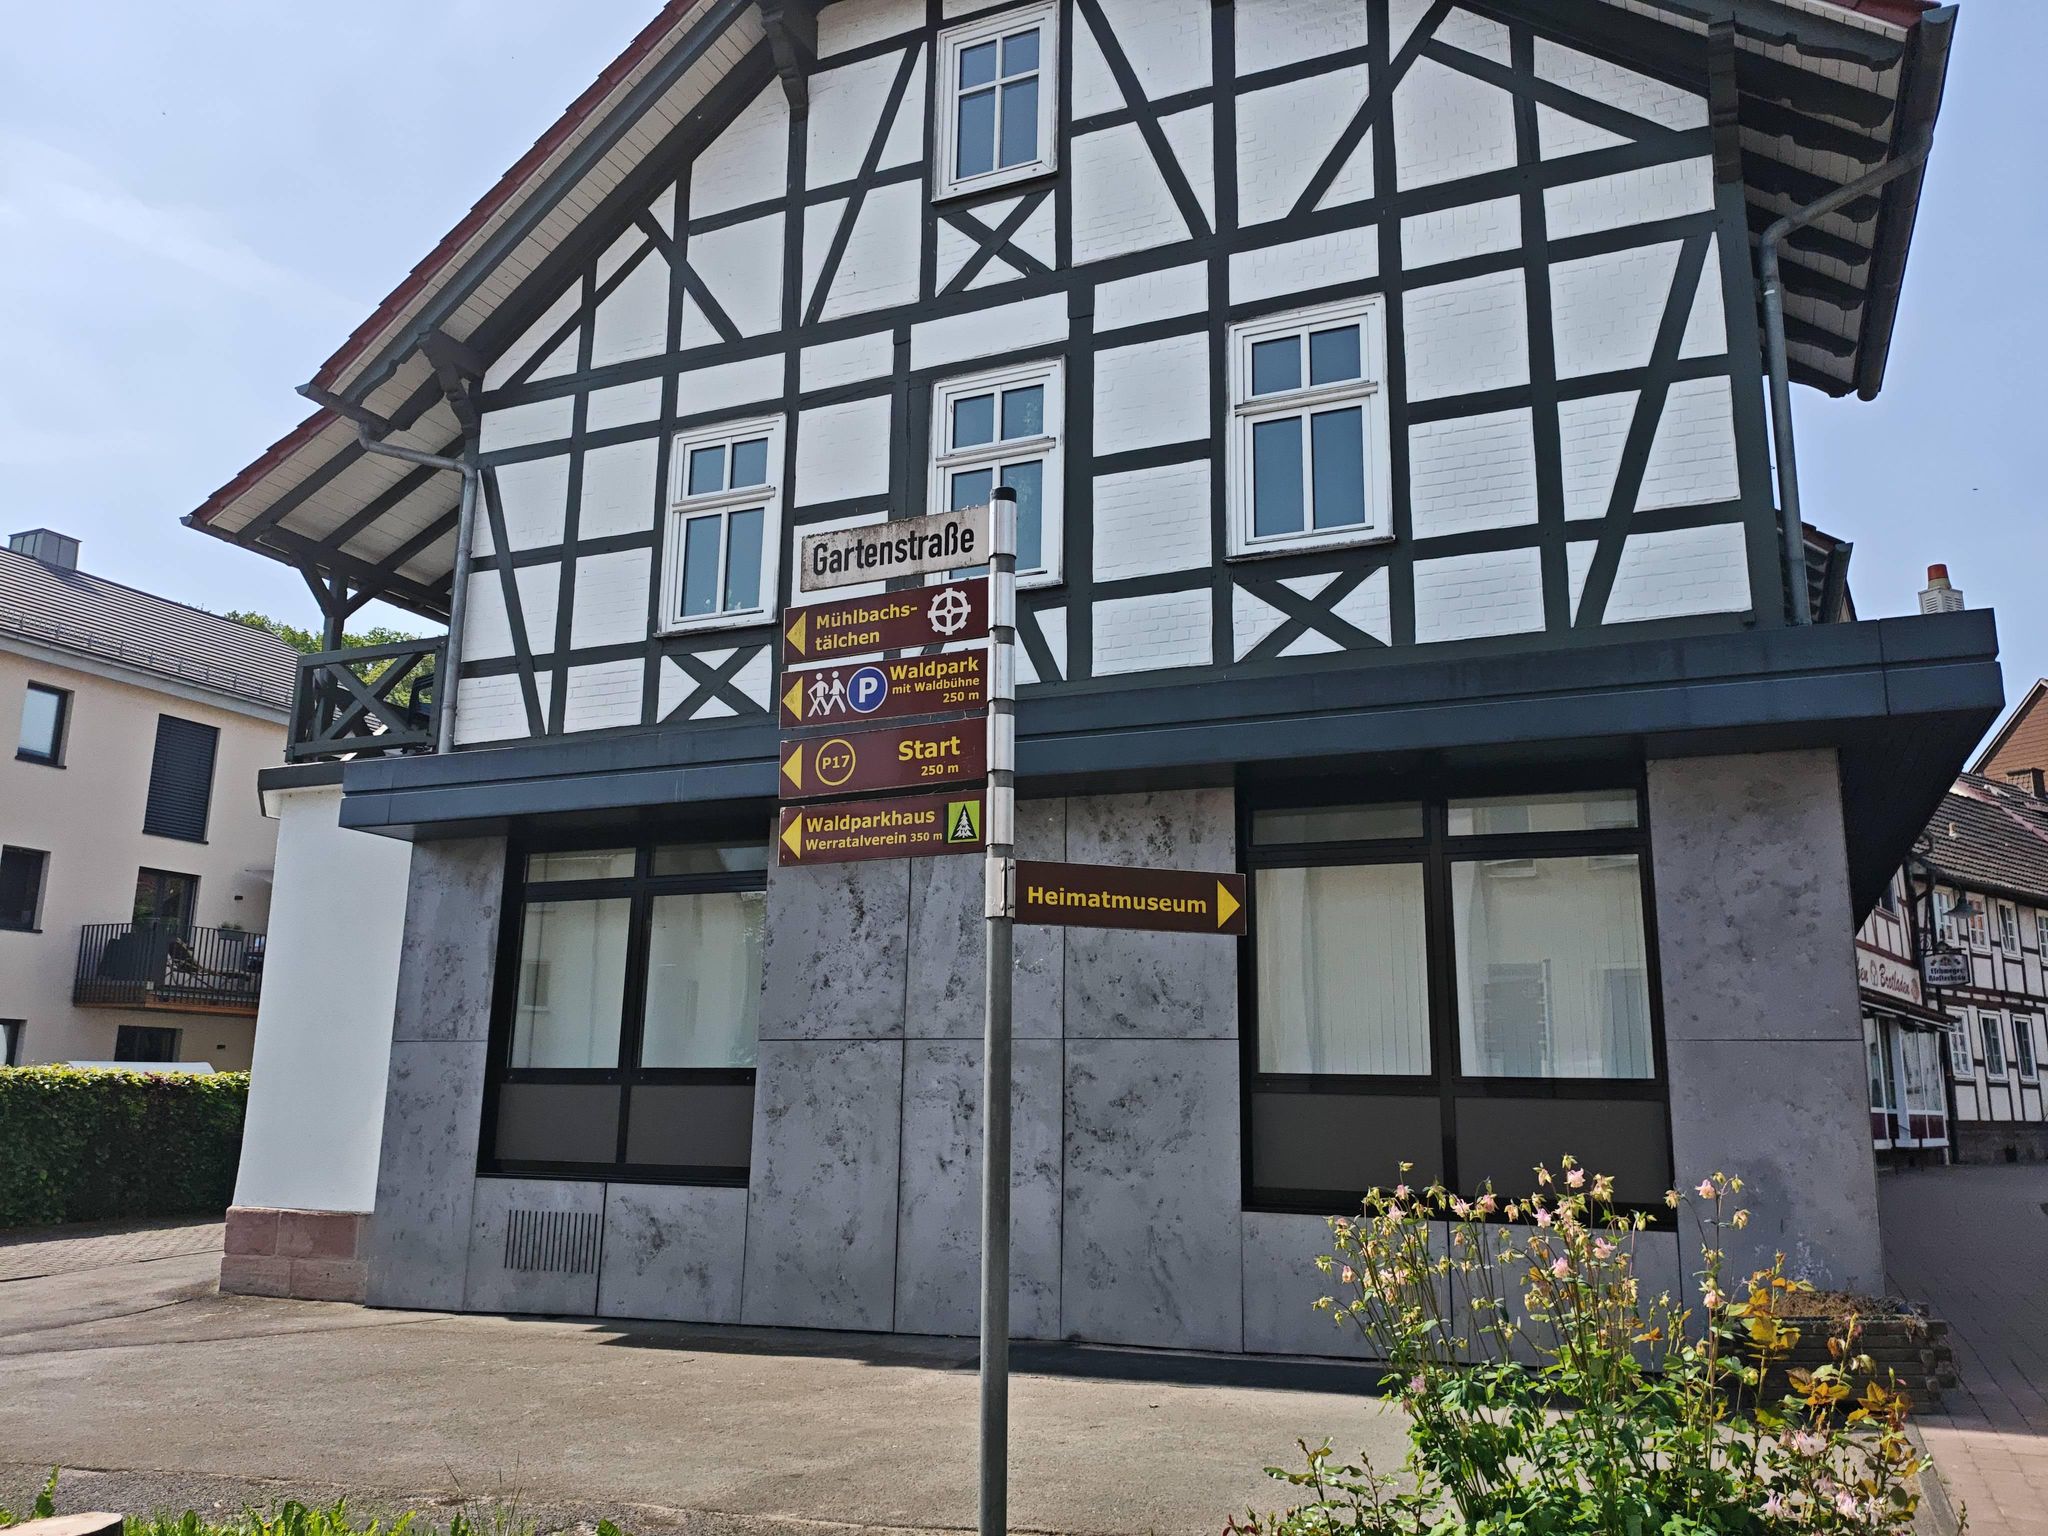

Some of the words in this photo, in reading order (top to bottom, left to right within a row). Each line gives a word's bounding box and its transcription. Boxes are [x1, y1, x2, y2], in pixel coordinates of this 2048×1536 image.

[813, 521, 975, 577] Gartenstraße
[815, 604, 918, 630] Mühlbachs-
[815, 629, 880, 651] tälchen
[889, 657, 980, 681] Waldpark
[858, 678, 878, 703] P
[892, 683, 911, 693] mit
[914, 677, 980, 692] Waldbühne
[943, 692, 966, 703] 250
[968, 692, 980, 700] m
[898, 735, 961, 761] Start
[821, 754, 850, 769] P17
[921, 764, 944, 776] 250
[947, 764, 959, 774] m
[806, 810, 936, 834] Waldparkhaus
[805, 832, 907, 851] Werratalverein
[910, 832, 931, 843] 350
[932, 832, 943, 841] m
[1028, 886, 1208, 914] Heimatmuseum
[1879, 963, 1910, 995] Brotladen
